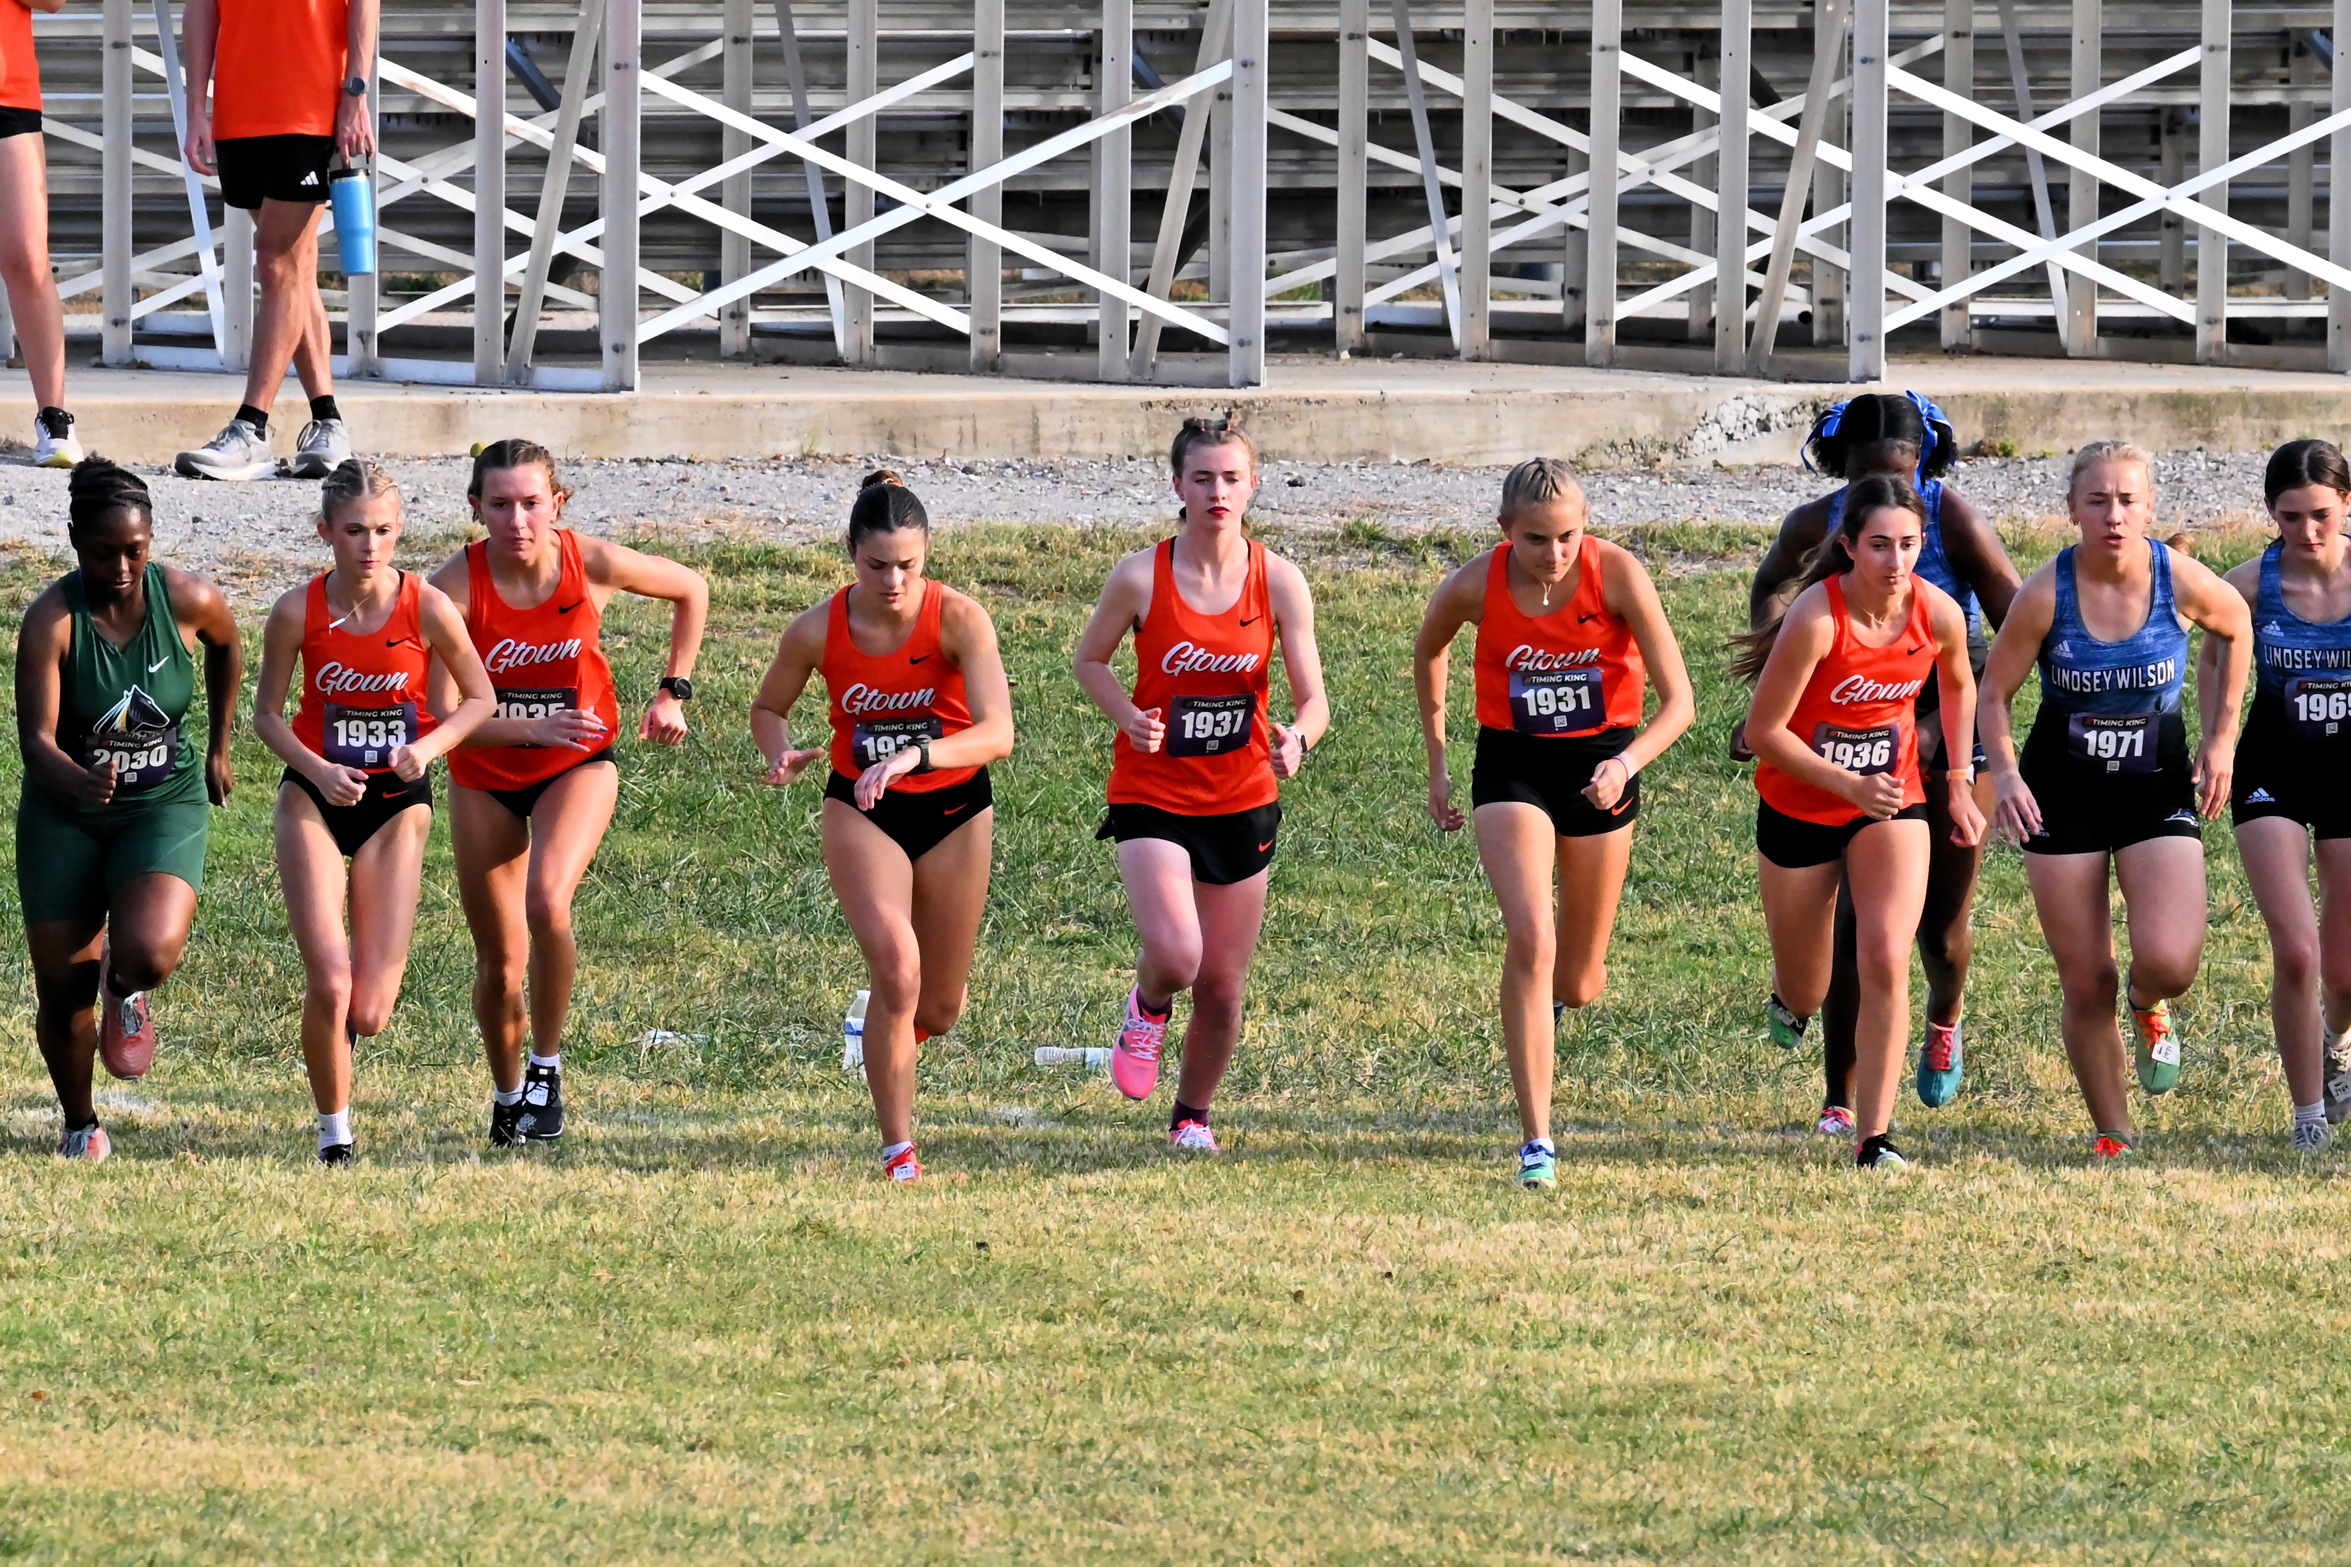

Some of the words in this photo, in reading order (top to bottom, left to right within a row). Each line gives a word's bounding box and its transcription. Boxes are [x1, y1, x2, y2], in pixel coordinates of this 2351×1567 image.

[485, 638, 582, 674] Gtown
[1161, 641, 1259, 677] Gtown
[1505, 644, 1601, 671] Gtown
[2264, 644, 2322, 669] LINDSEY
[315, 661, 409, 696] Gtown
[1532, 675, 1562, 683] TIMING
[1564, 674, 1587, 682] KING
[2051, 664, 2112, 692] LINDSEY
[2116, 658, 2175, 689] WILSON
[841, 683, 936, 715] Gtown
[1226, 699, 1247, 707] KING
[1521, 686, 1591, 716] 1931
[1830, 674, 1922, 706] Gtown
[380, 709, 403, 717] KING
[2294, 692, 2351, 722] 196
[333, 720, 407, 748] 1933
[874, 724, 904, 732] TIMING
[906, 722, 928, 730] KING
[1181, 709, 1246, 738] 1937
[1837, 731, 1867, 740] TIMING
[1868, 730, 1890, 738] KING
[2092, 719, 2123, 727] TIMING
[2126, 718, 2147, 726] KING
[109, 740, 140, 748] TIMING
[862, 734, 933, 762] 193
[1820, 740, 1891, 770] 1936
[2083, 729, 2145, 758] 1971
[93, 744, 168, 773] 2030
